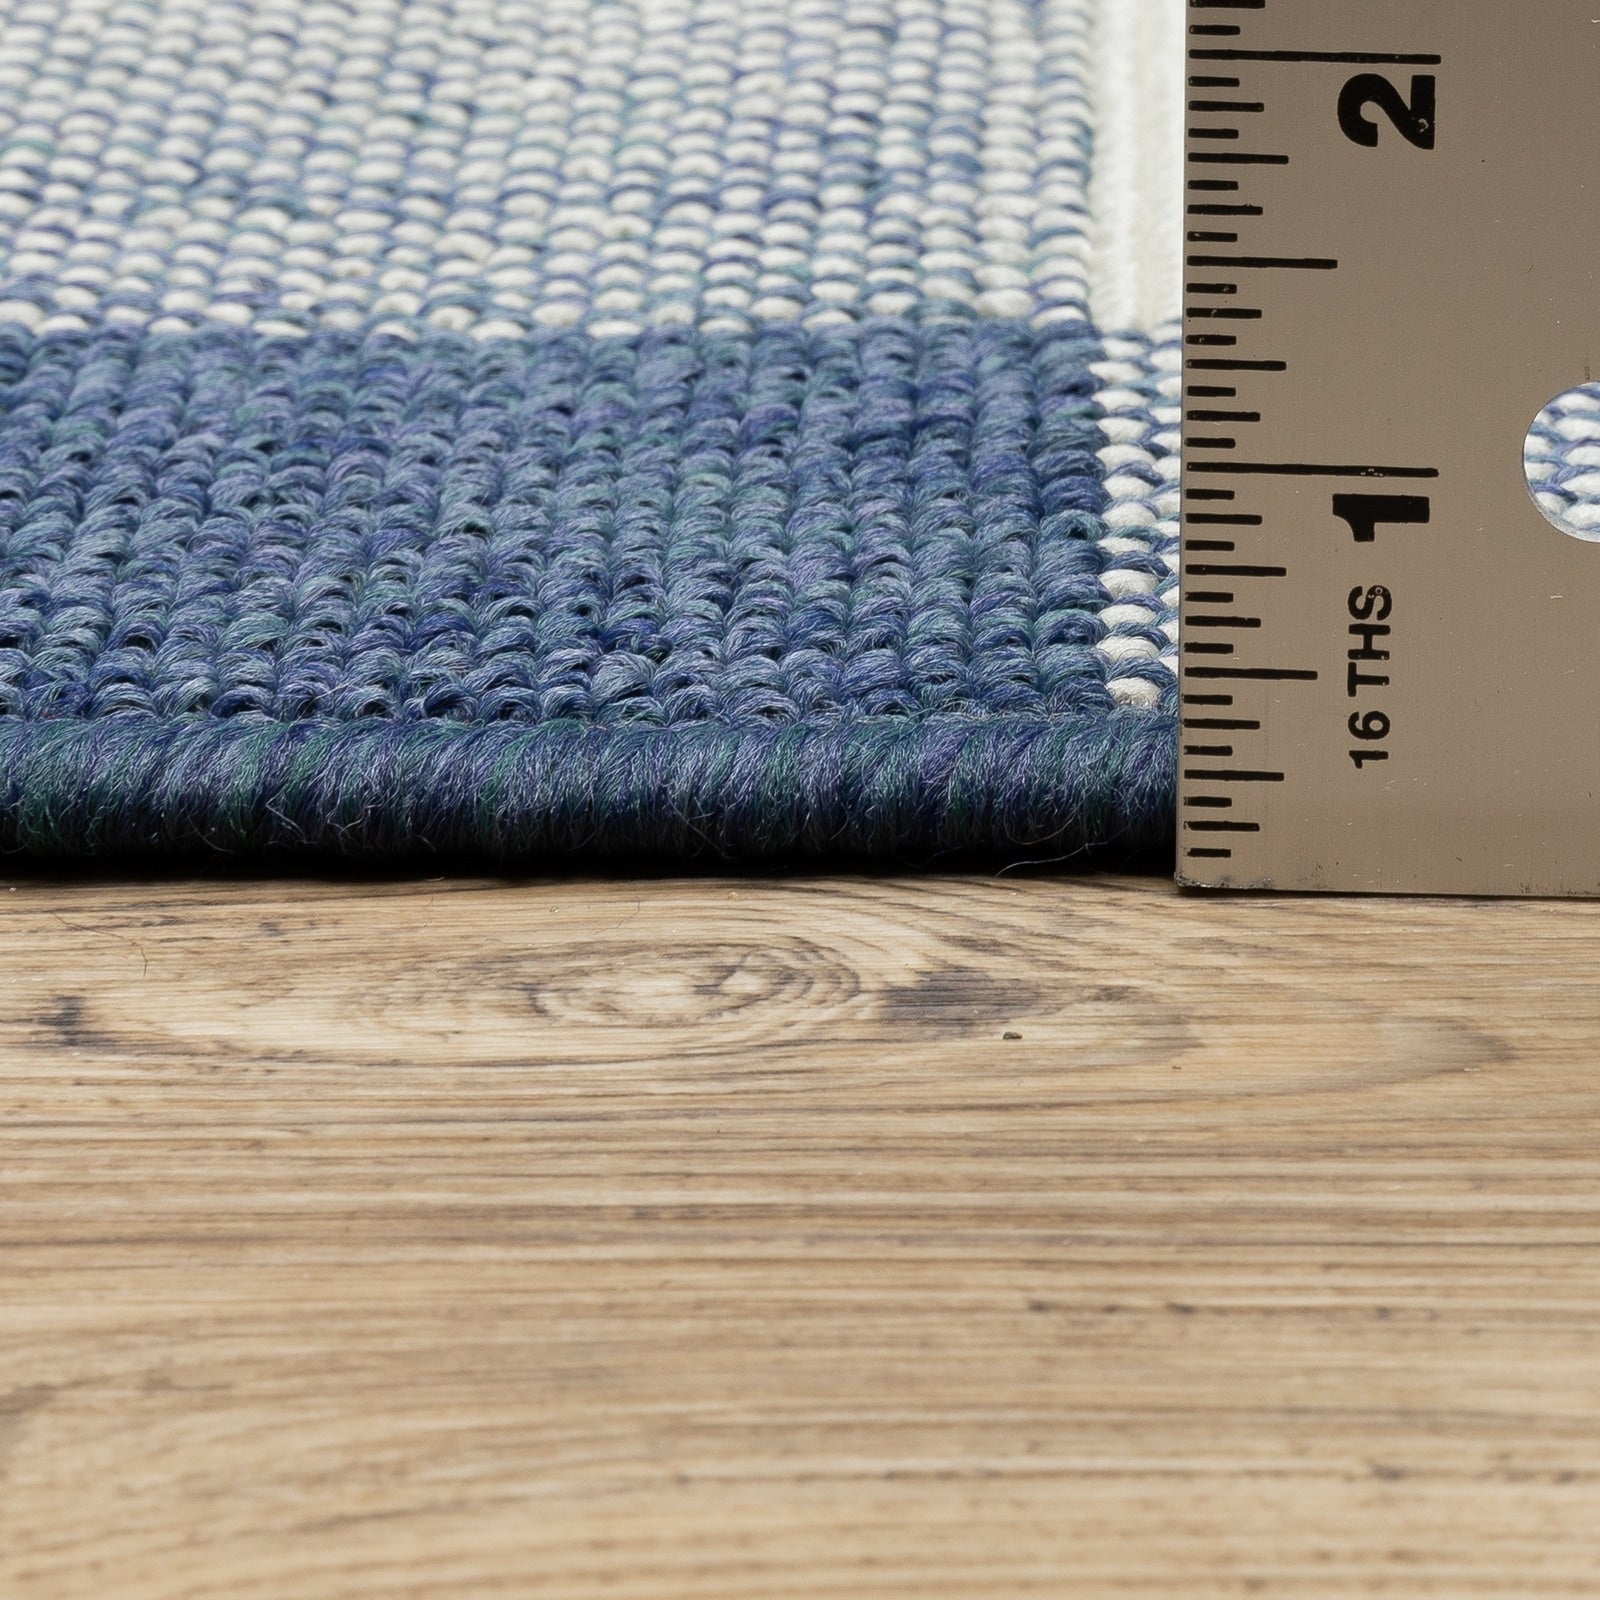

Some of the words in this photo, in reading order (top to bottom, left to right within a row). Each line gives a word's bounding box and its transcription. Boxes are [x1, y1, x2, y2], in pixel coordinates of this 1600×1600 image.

[1337, 73, 1436, 150] 2
[1332, 493, 1431, 543] 1
[1347, 585, 1393, 698] THS
[1347, 710, 1391, 769] 16
